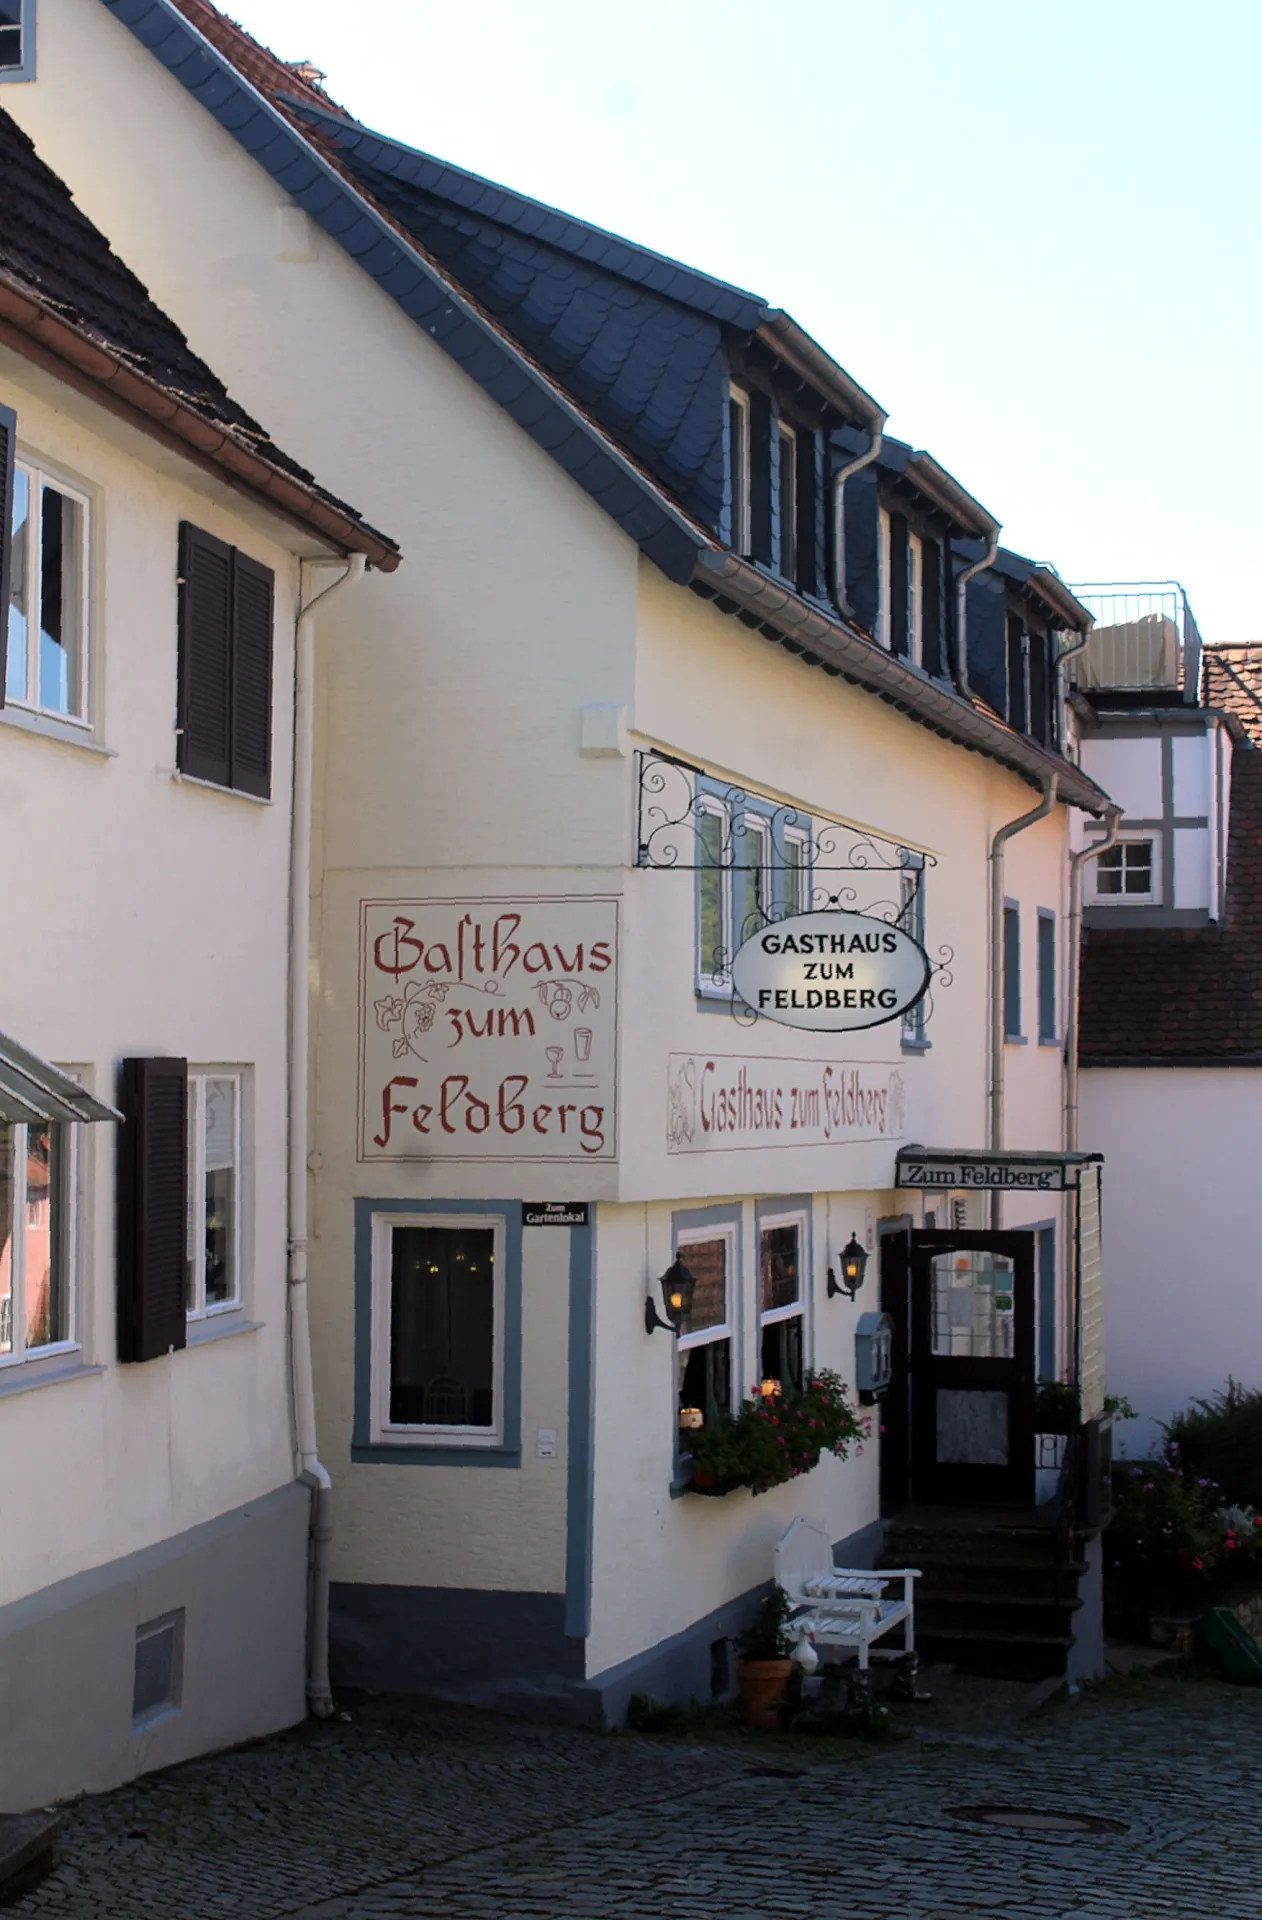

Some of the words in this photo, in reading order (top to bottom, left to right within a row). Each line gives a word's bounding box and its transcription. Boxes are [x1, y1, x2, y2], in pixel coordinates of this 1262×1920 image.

[761, 933, 898, 954] GASTHAUS
[803, 963, 854, 979] ZUM
[758, 989, 898, 1009] FELDBERG
[445, 1007, 536, 1048] zum
[700, 1061, 783, 1132] Gasthaus
[790, 1087, 820, 1129] zum
[373, 1074, 605, 1153] Feldberg
[526, 1212, 584, 1223] Gartenlokal
[545, 1203, 565, 1212] Zum
